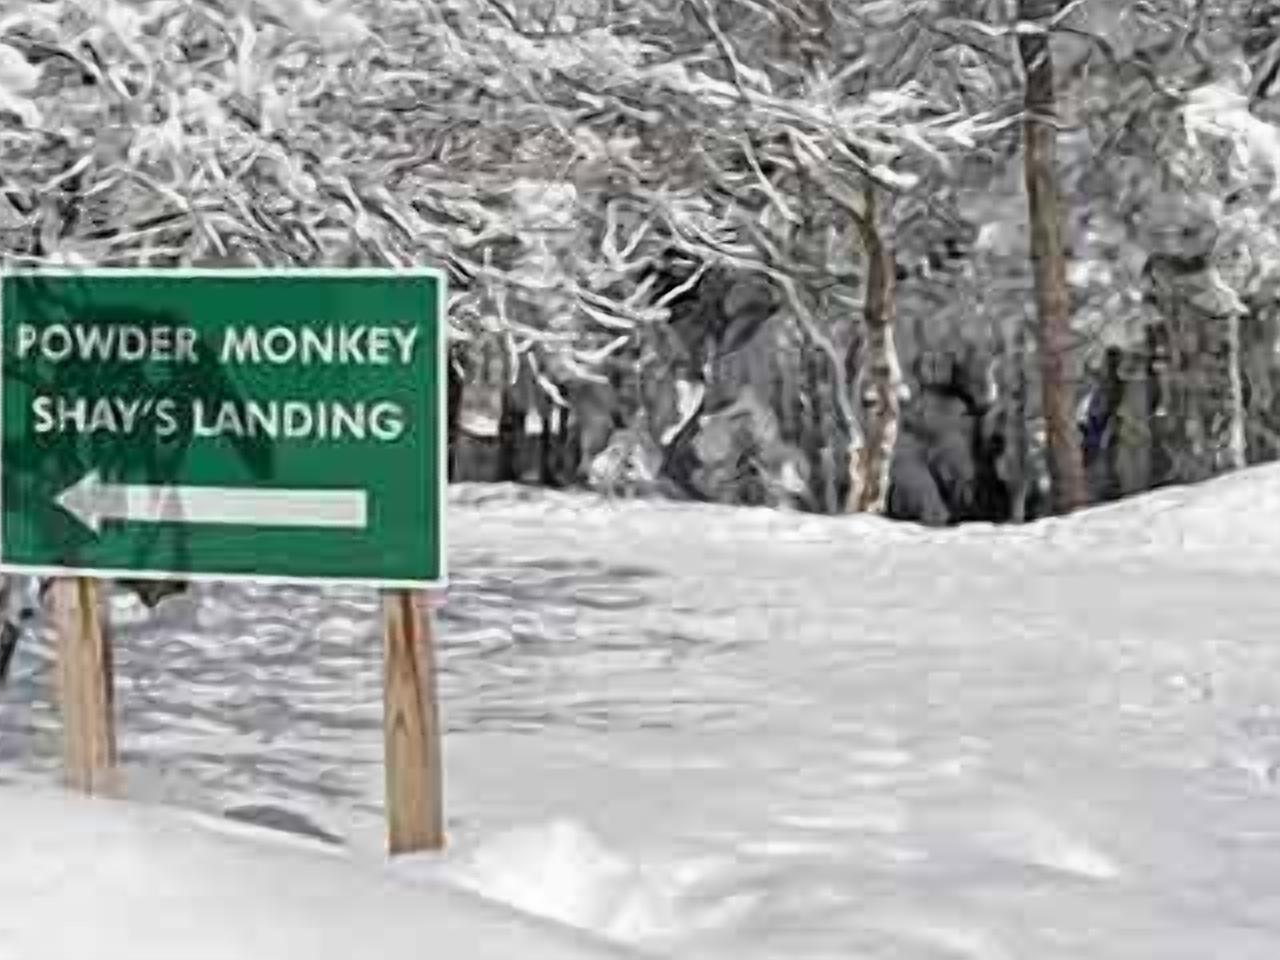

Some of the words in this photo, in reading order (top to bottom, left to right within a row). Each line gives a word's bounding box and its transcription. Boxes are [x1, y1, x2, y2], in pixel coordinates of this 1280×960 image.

[17, 325, 198, 363] POWDER
[220, 326, 418, 364] MONKEY
[31, 395, 177, 436] SHAY'S
[192, 400, 404, 440] LANDING
